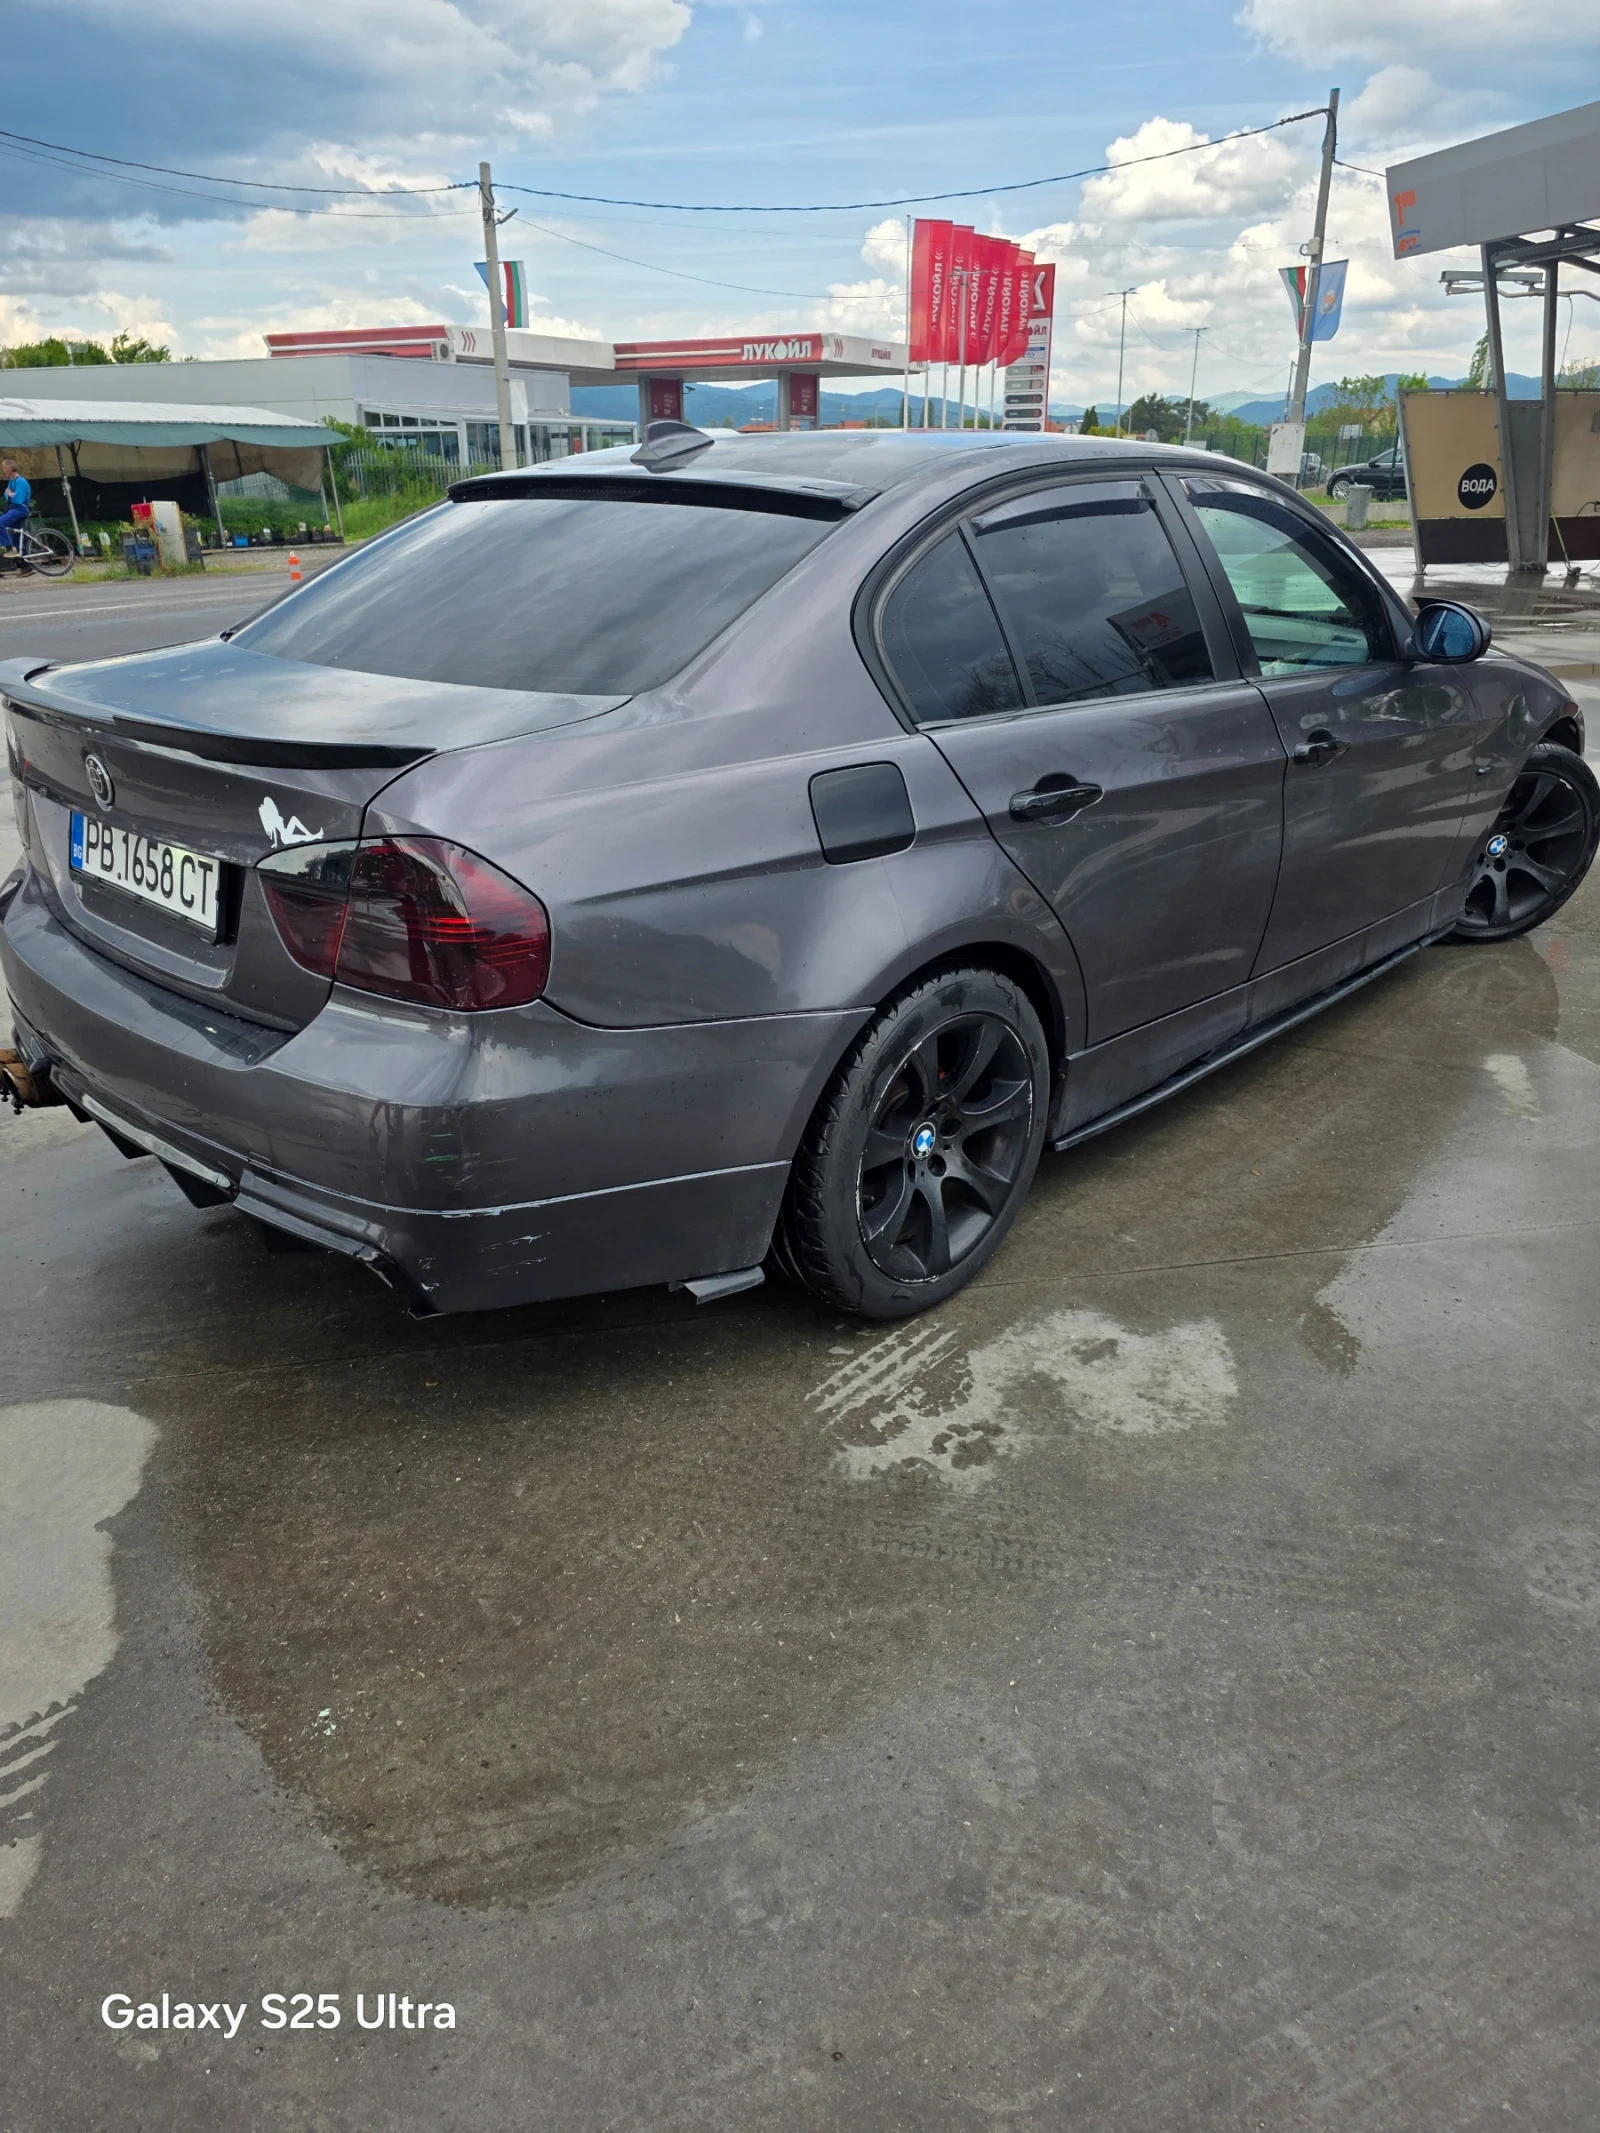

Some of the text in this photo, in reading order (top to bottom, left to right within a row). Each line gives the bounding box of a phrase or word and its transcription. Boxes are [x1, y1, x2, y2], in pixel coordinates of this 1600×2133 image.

[969, 273, 980, 330] ЛУКОЙЛ
[982, 276, 998, 333] ЛУКОЙЛ
[1000, 277, 1012, 333] ЛУКОЙЛ
[742, 338, 811, 361] ЛУКОЙЛ
[1461, 479, 1494, 494] ВОДА
[73, 843, 82, 860] BG
